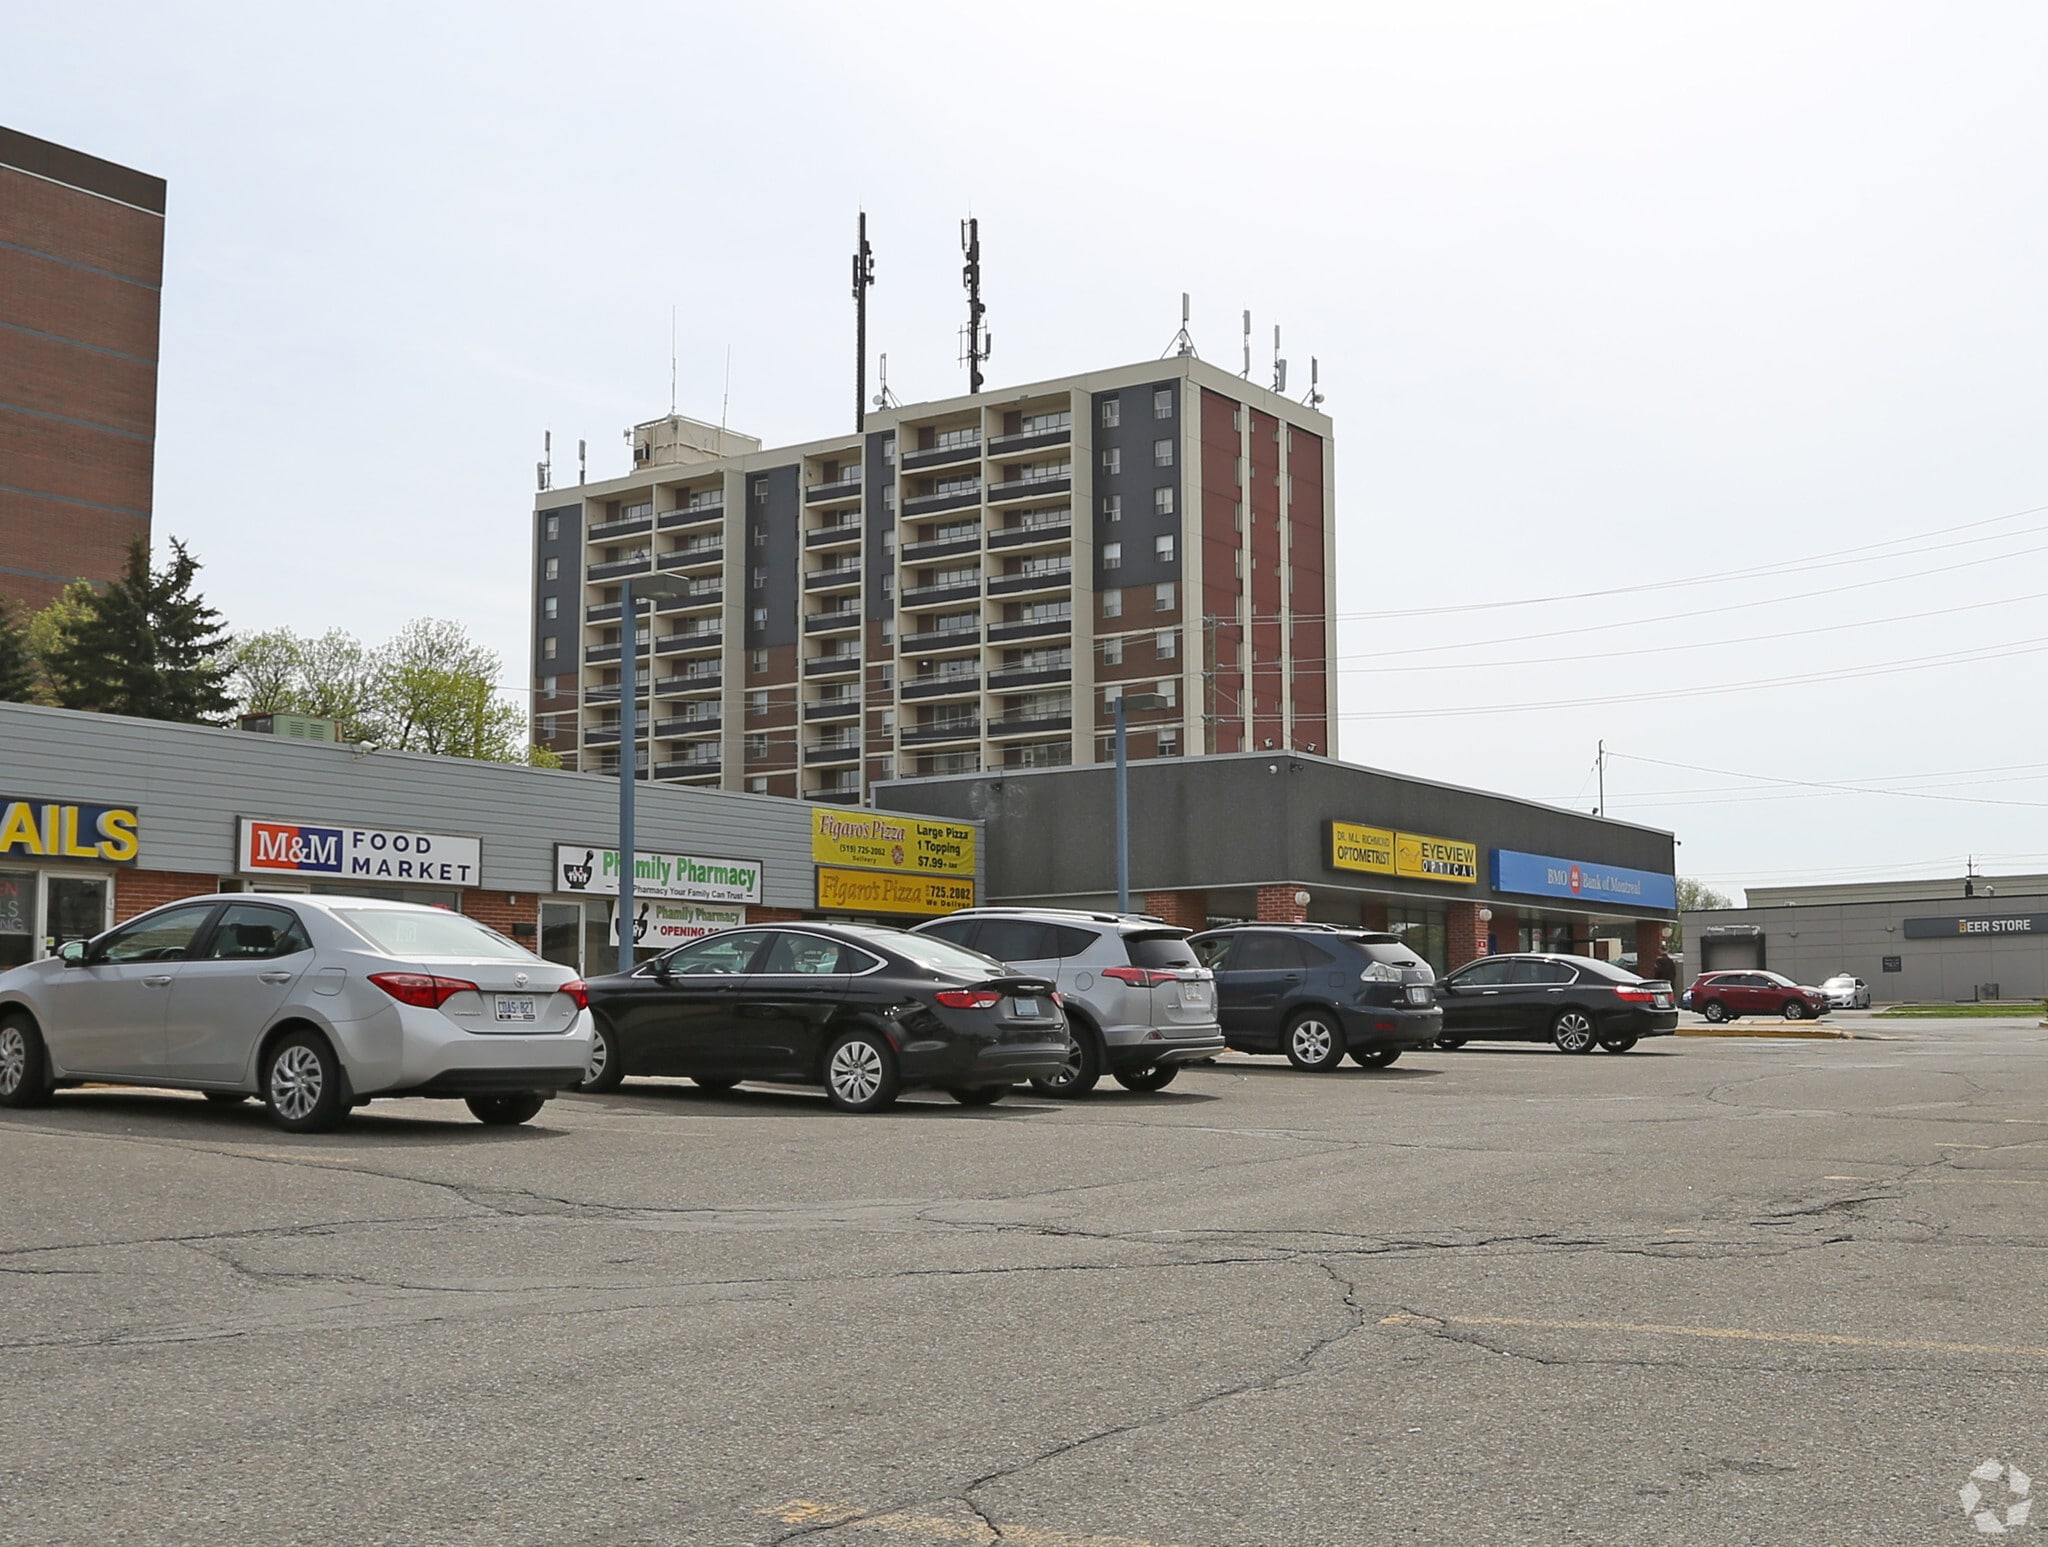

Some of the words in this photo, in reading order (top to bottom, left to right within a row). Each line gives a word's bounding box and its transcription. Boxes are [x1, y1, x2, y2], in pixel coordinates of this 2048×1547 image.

[820, 815, 869, 841] Figaro's
[872, 820, 905, 842] Pizza
[917, 824, 943, 839] Large
[946, 827, 969, 840] Pizza
[256, 830, 338, 865] M&M
[352, 831, 432, 854] FOOD
[917, 840, 922, 850] 1
[925, 840, 961, 856] Topping
[1337, 845, 1390, 865] OPTOMETRIST
[1421, 842, 1474, 863] EYEVIEW
[351, 857, 471, 882] MARKET
[603, 851, 671, 886] Phmily
[677, 857, 756, 892] Pharmacy
[1422, 860, 1475, 877] OPTICAL
[882, 879, 922, 903] Pizza
[1548, 869, 1567, 885] BMO
[1583, 873, 1601, 889] Bank
[1602, 877, 1609, 890] of
[1611, 878, 1640, 894] Montreal
[669, 887, 686, 896] Your
[688, 888, 711, 899] Family
[711, 890, 725, 899] Can
[727, 891, 743, 900] Trust
[656, 905, 694, 924] Phamily
[696, 908, 740, 925] Pharmacy
[941, 901, 971, 909] Deliver
[660, 925, 705, 937] OPENING
[1959, 919, 1990, 933] BEER
[1992, 919, 2031, 932] STORE
